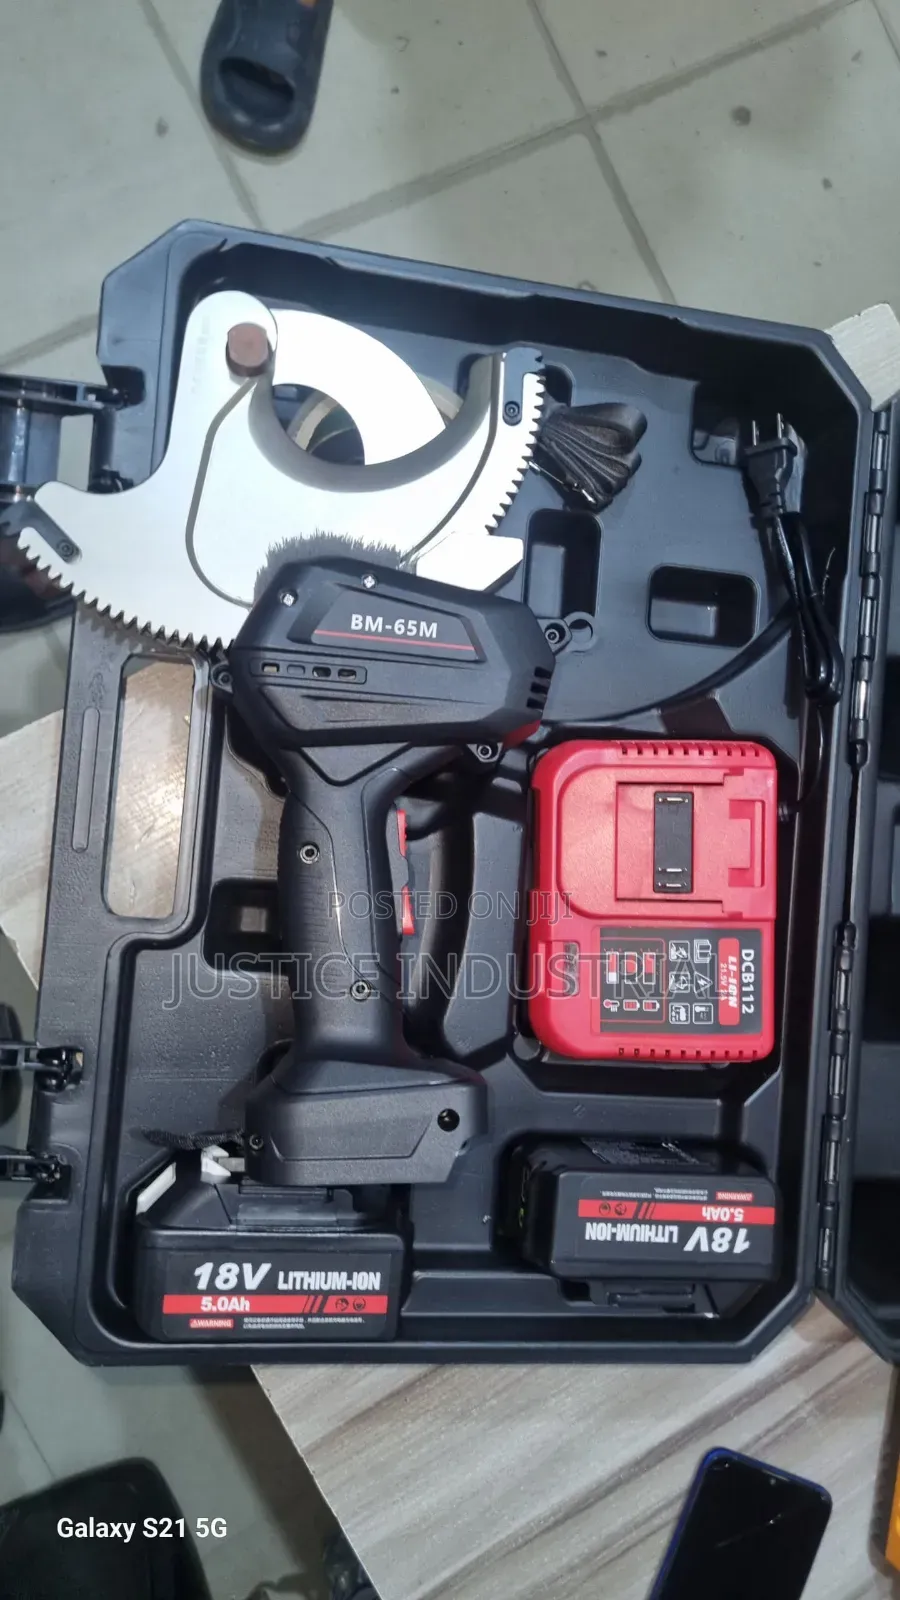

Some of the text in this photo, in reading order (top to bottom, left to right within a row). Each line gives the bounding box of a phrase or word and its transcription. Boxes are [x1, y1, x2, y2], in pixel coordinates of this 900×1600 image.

[350, 613, 438, 638] BM-65M
[741, 948, 755, 1014] DCB112
[702, 1206, 744, 1222] 5.0Ah
[585, 1222, 751, 1253] 18V LITHIUM-ION
[194, 1262, 381, 1290] 18V LITHIUM-ION
[200, 1296, 250, 1312] 5.0Ah
[198, 1320, 232, 1328] WARNING
